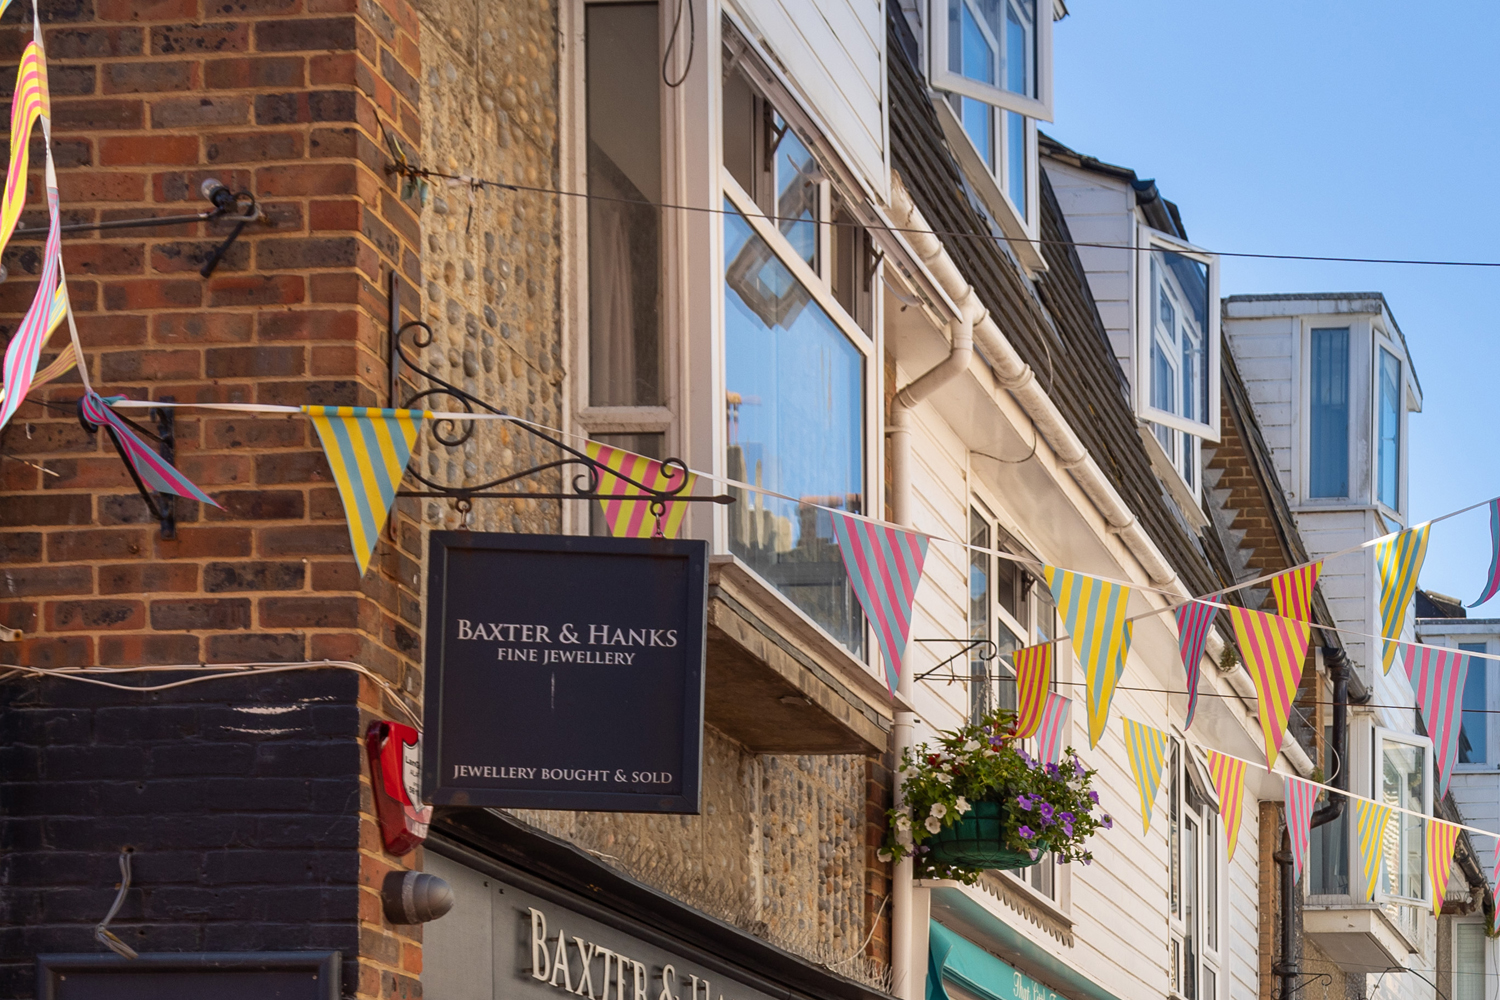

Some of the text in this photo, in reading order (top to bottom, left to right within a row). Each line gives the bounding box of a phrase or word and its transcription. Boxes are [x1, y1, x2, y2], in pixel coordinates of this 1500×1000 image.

[456, 618, 679, 649] BAXTER & HANKS
[496, 646, 637, 668] FINE JEWELLERY
[453, 764, 674, 785] JEWELLERY BOUGHT & SOLD
[1013, 971, 1031, 1000] That
